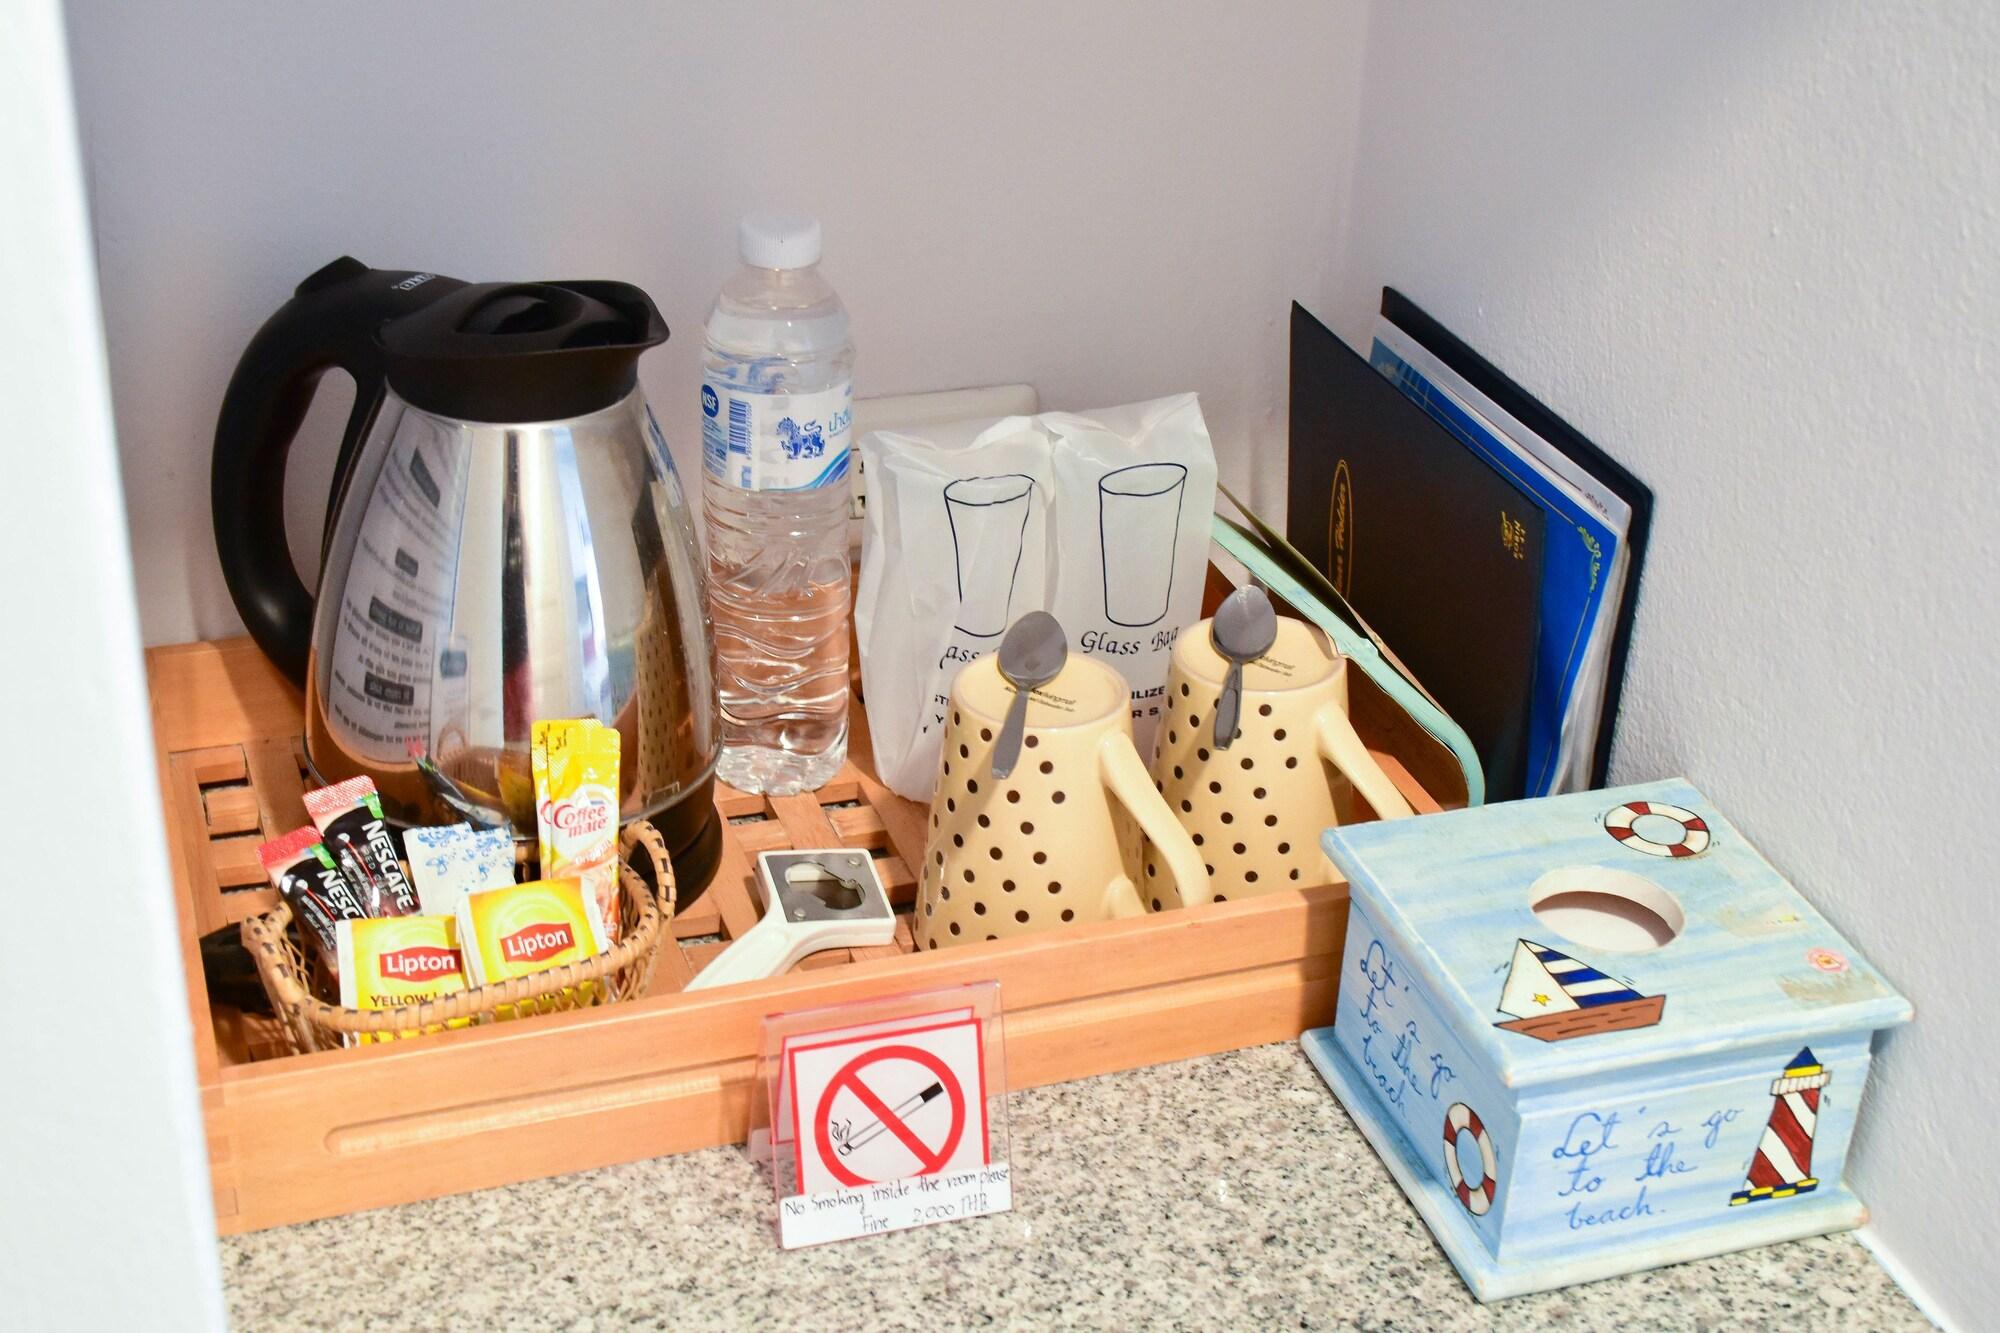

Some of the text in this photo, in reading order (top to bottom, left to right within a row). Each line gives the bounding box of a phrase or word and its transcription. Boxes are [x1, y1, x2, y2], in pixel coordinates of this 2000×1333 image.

[1080, 630, 1141, 655] Glass
[554, 804, 605, 829] Coffee
[568, 817, 607, 838] mate
[317, 869, 360, 919] NESC
[506, 930, 570, 957] Lipton
[386, 954, 456, 976] Lipton
[370, 994, 429, 1007] YELLOW
[1360, 987, 1423, 1097] to the
[1430, 1053, 1457, 1100] go
[1701, 1108, 1744, 1149] go
[1558, 1141, 1698, 1197] to the
[785, 1201, 805, 1216] No
[872, 1179, 910, 1201] inside
[917, 1175, 940, 1192] the
[946, 1173, 976, 1188] room
[980, 1165, 1009, 1192] please
[862, 1214, 889, 1232] Fine
